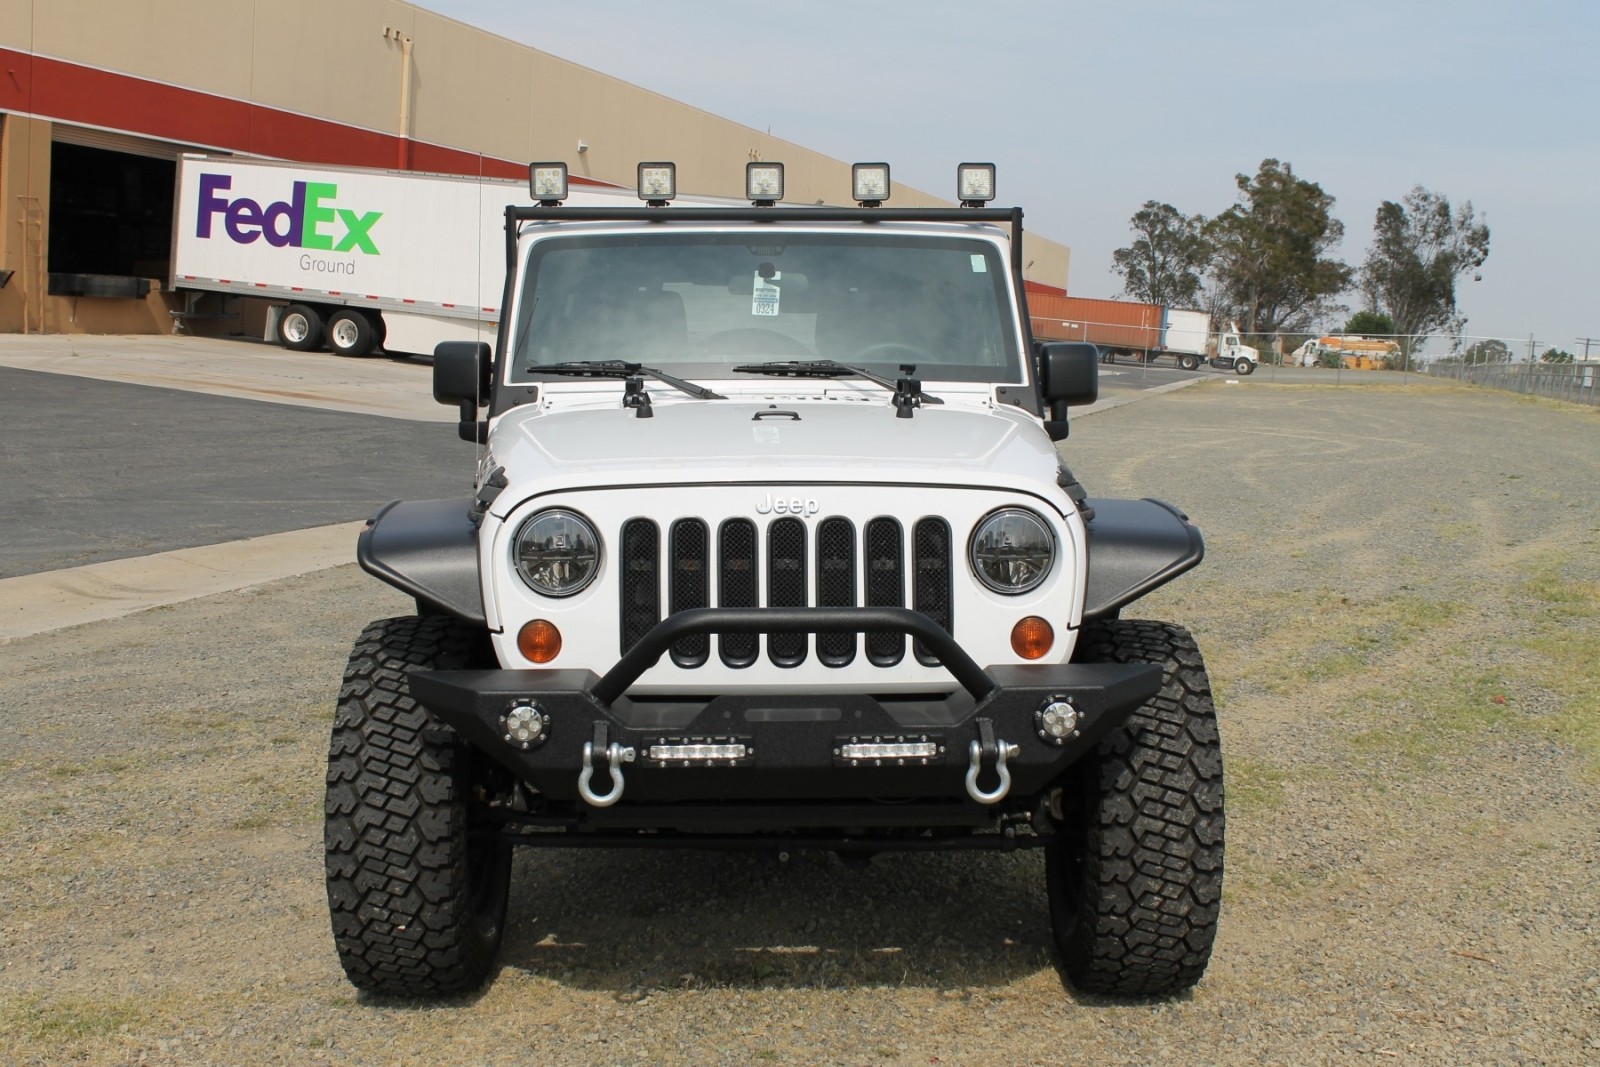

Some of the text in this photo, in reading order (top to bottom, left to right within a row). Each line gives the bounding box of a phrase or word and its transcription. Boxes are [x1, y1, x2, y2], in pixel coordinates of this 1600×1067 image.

[196, 173, 384, 255] FedEx
[299, 254, 355, 275] Ground
[756, 303, 775, 315] 0324
[756, 493, 819, 518] Jeep
